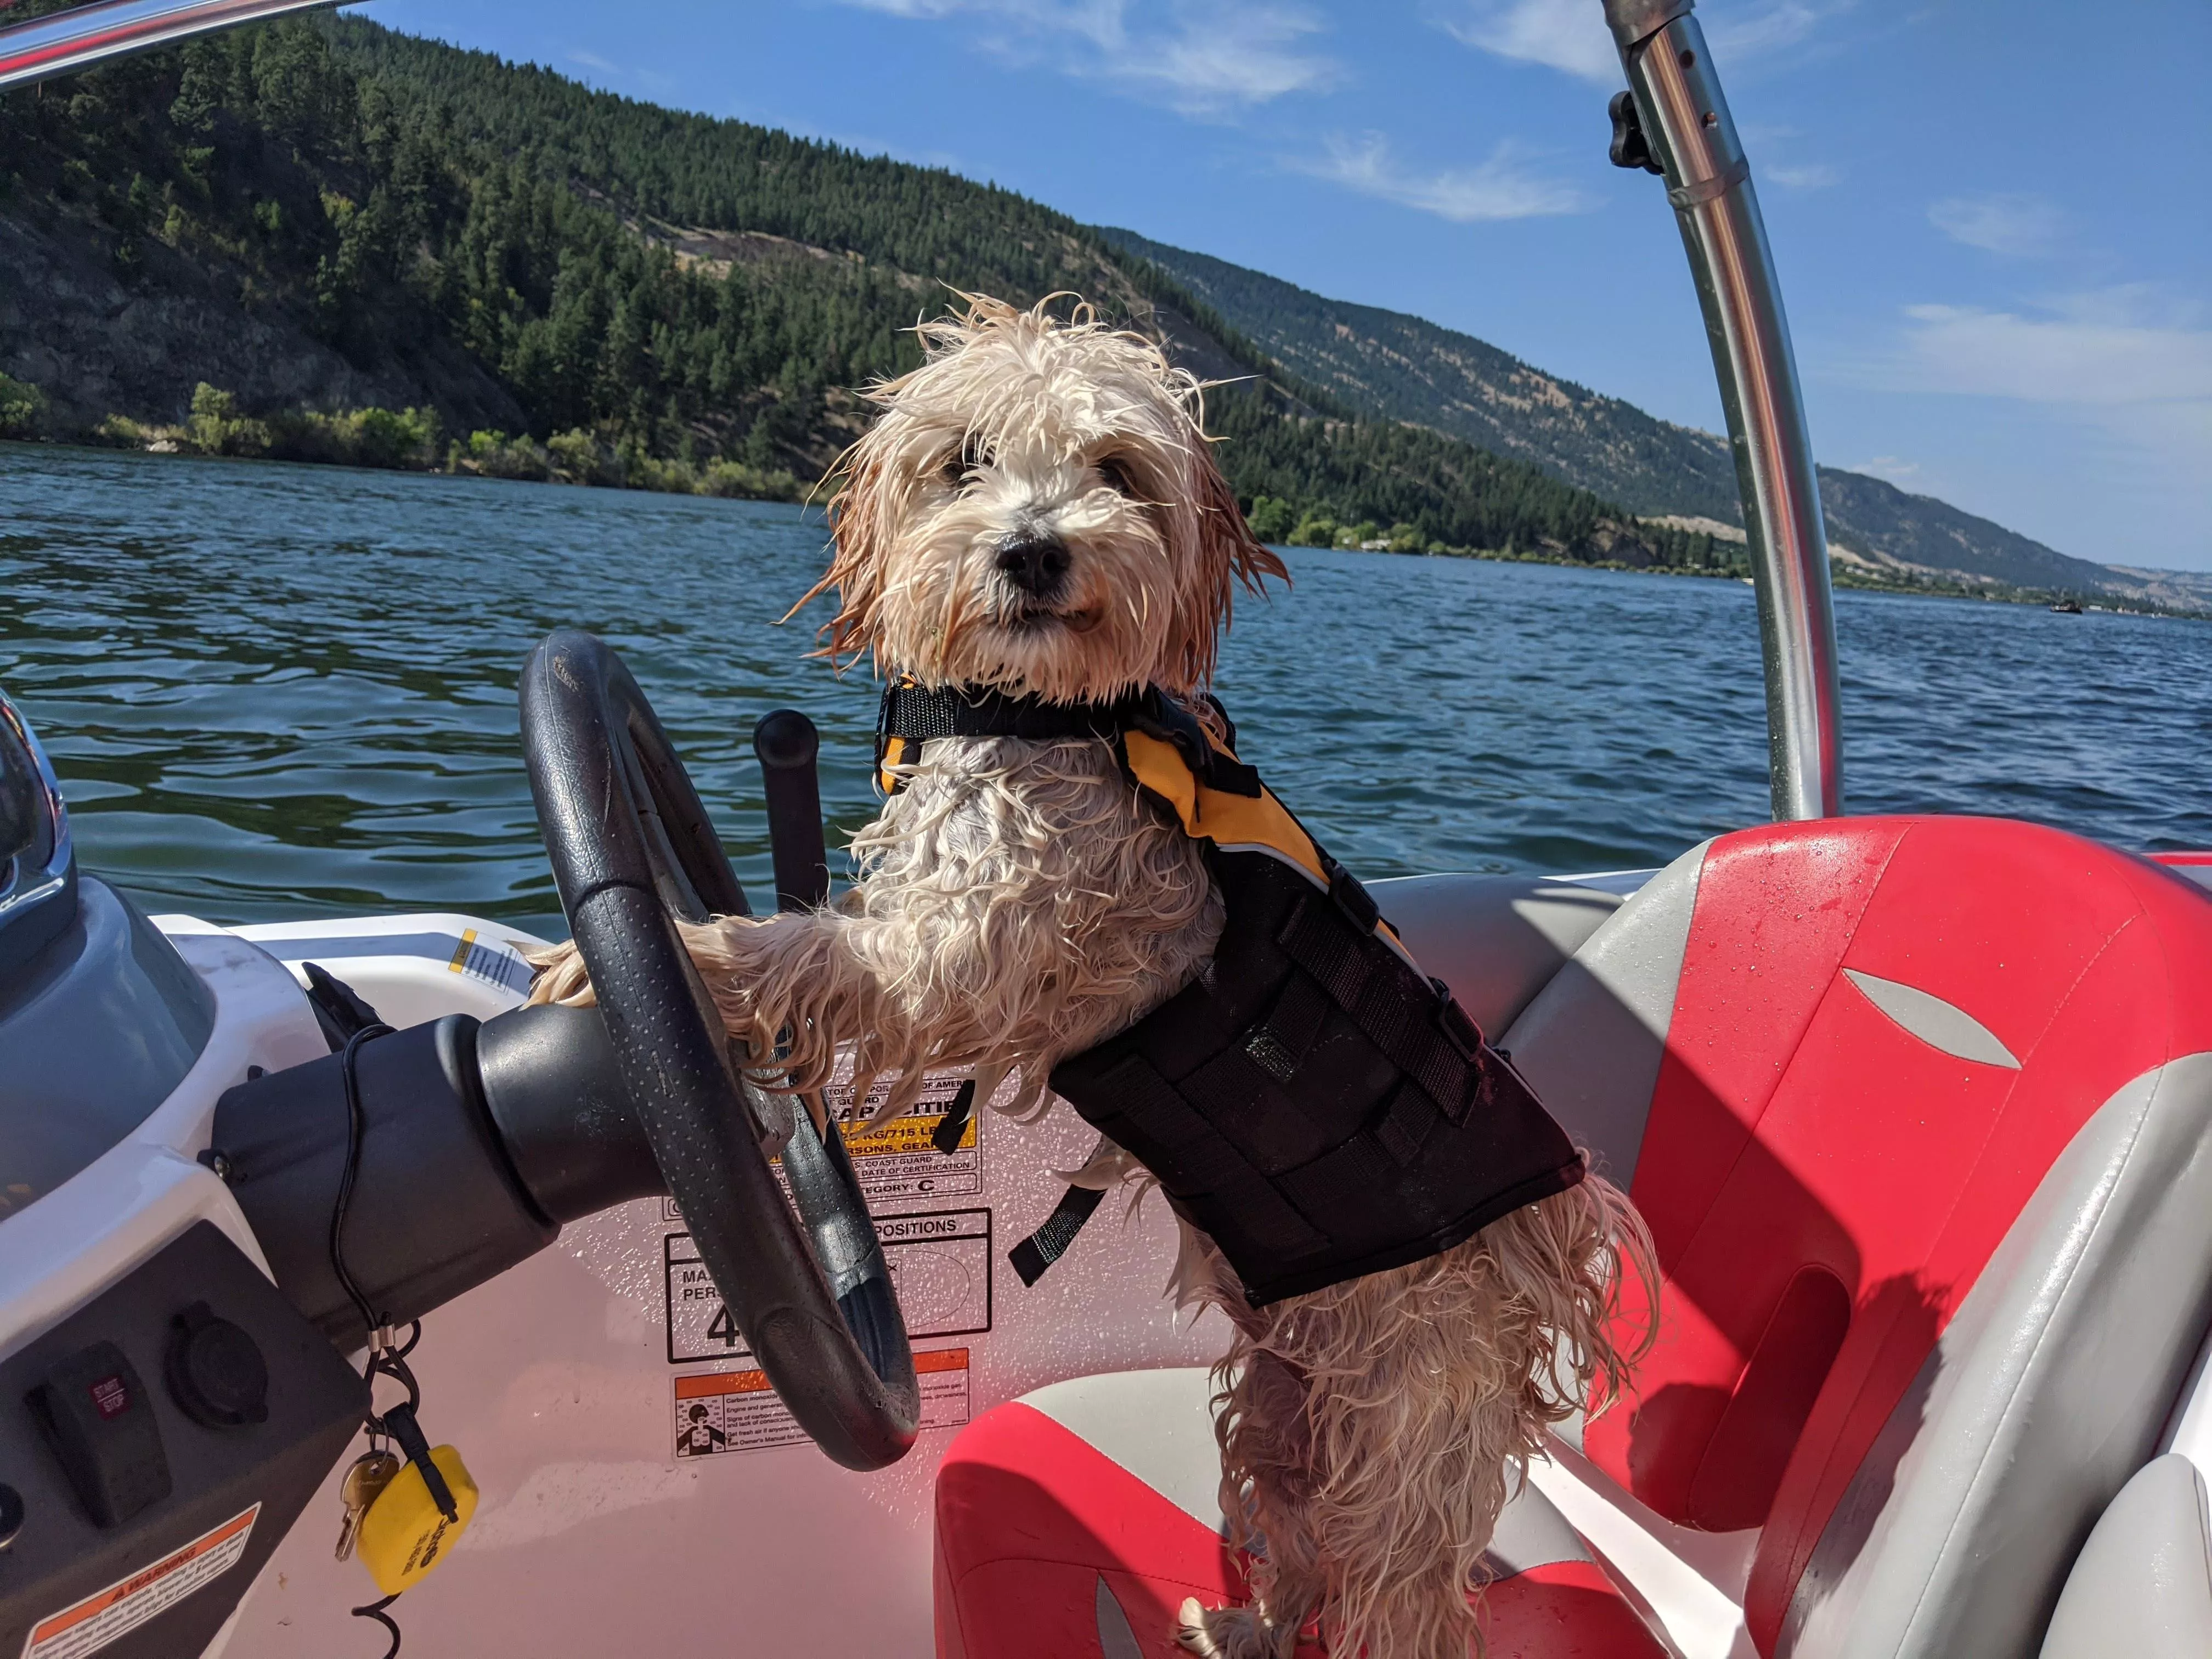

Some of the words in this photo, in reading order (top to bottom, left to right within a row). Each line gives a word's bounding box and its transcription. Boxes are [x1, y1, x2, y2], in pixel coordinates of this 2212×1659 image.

[838, 1097, 879, 1105] GURD
[921, 1126, 938, 1136] LB
[865, 1159, 896, 1167] COAST
[903, 1161, 970, 1173] CERTIFICATION
[917, 1180, 935, 1192] C
[683, 1269, 712, 1283] MA
[684, 1286, 720, 1301] PER
[707, 1304, 740, 1347] 4
[104, 1394, 124, 1412] STOP
[128, 1547, 197, 1591] WARNING
